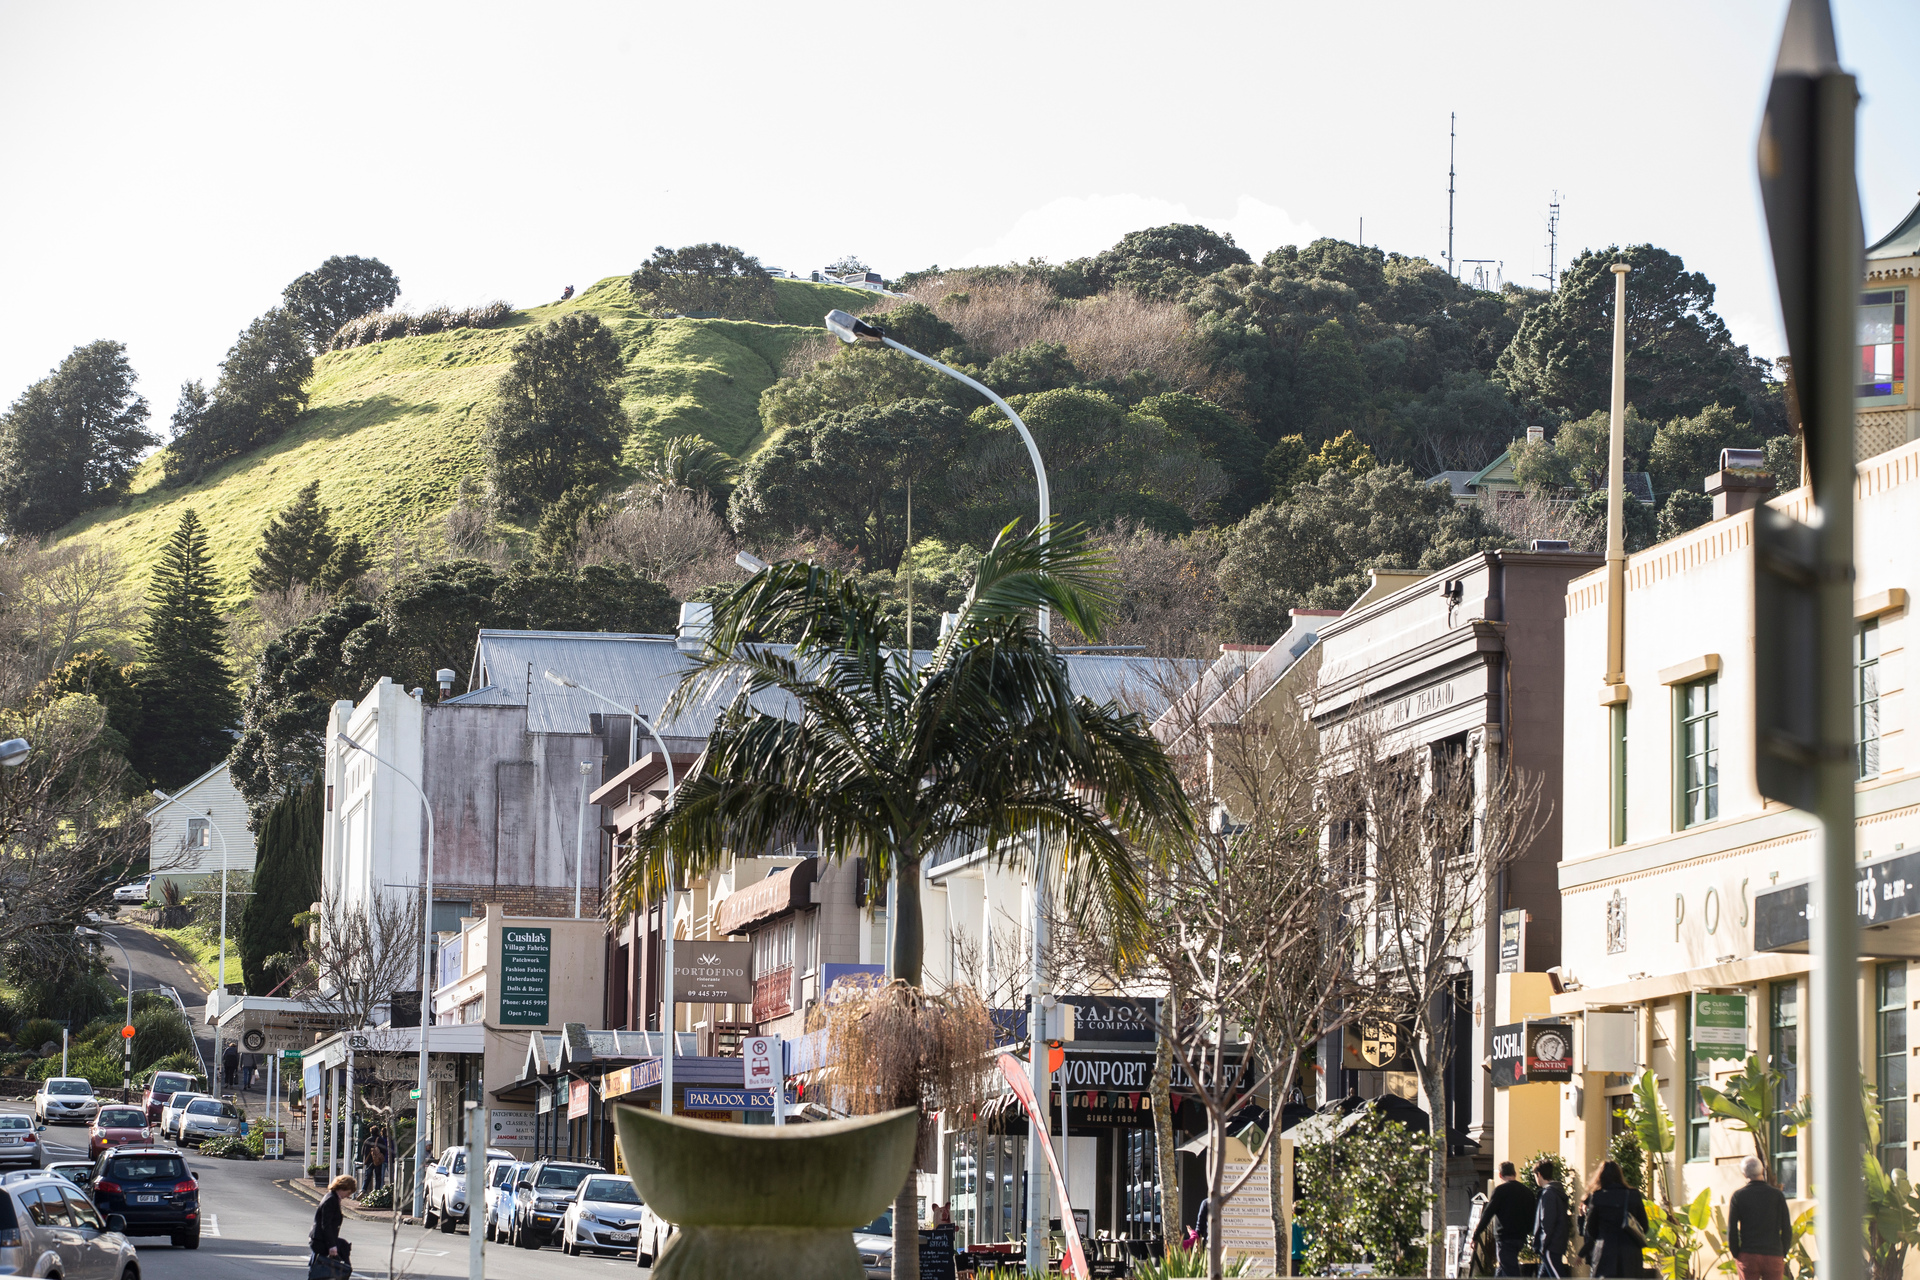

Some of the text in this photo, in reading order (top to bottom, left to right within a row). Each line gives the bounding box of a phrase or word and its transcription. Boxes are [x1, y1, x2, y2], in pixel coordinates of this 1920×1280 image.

[1416, 682, 1454, 716] ZEALAND
[507, 932, 546, 943] Cushla's
[504, 944, 549, 952] Village Fabrics
[674, 967, 744, 977] PORTOFINO
[1073, 1006, 1147, 1022] RAJOZ
[1089, 1021, 1145, 1031] COMPANY
[268, 1033, 309, 1041] VICTORIA
[268, 1041, 309, 1049] THEATRE
[1534, 1061, 1567, 1069] SANTINI
[760, 1077, 774, 1085] Stop
[690, 1093, 791, 1106] PARADOX BOOS
[676, 1110, 700, 1119] FISH
[704, 1111, 731, 1120] CHIPS
[1087, 1114, 1138, 1123] SINCE 1994
